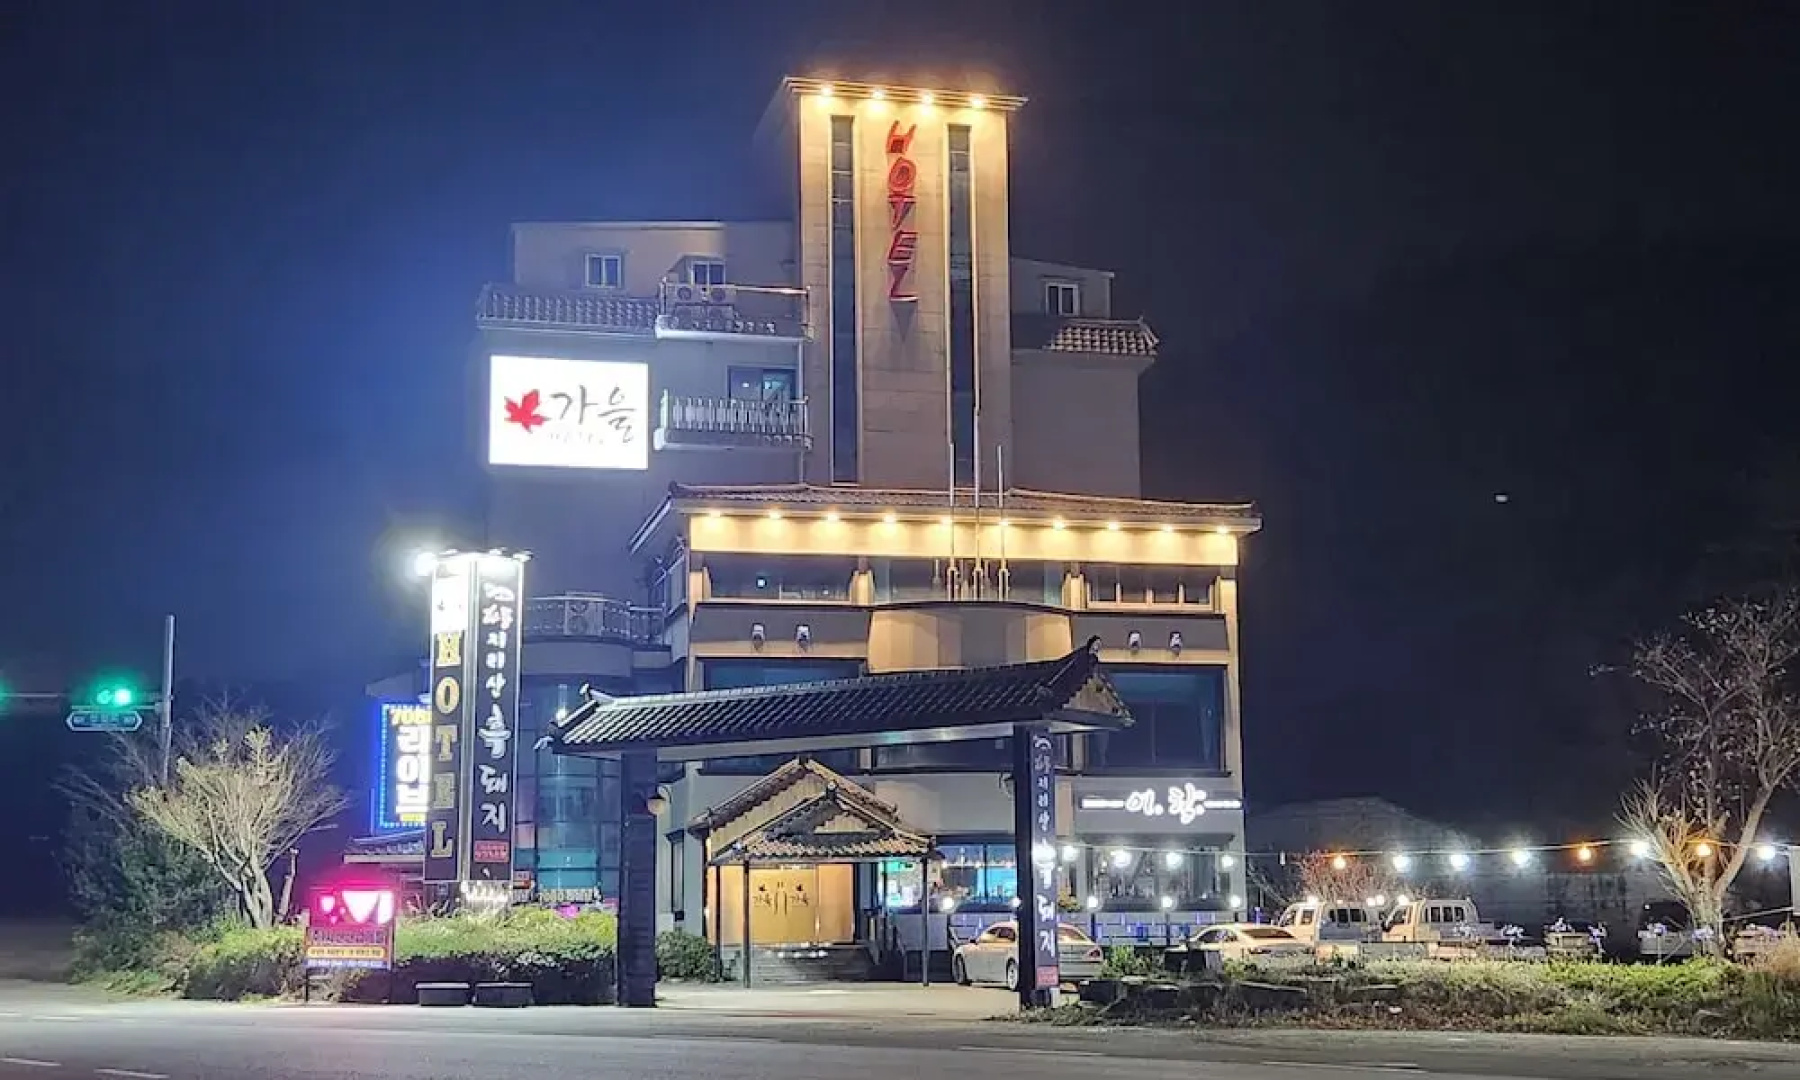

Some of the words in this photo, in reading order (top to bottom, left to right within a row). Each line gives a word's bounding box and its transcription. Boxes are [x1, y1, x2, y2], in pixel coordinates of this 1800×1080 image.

[886, 120, 919, 302] HOTEL
[549, 384, 638, 443] 가을
[430, 631, 461, 859] HOTEL
[478, 703, 513, 833] 흑돼지
